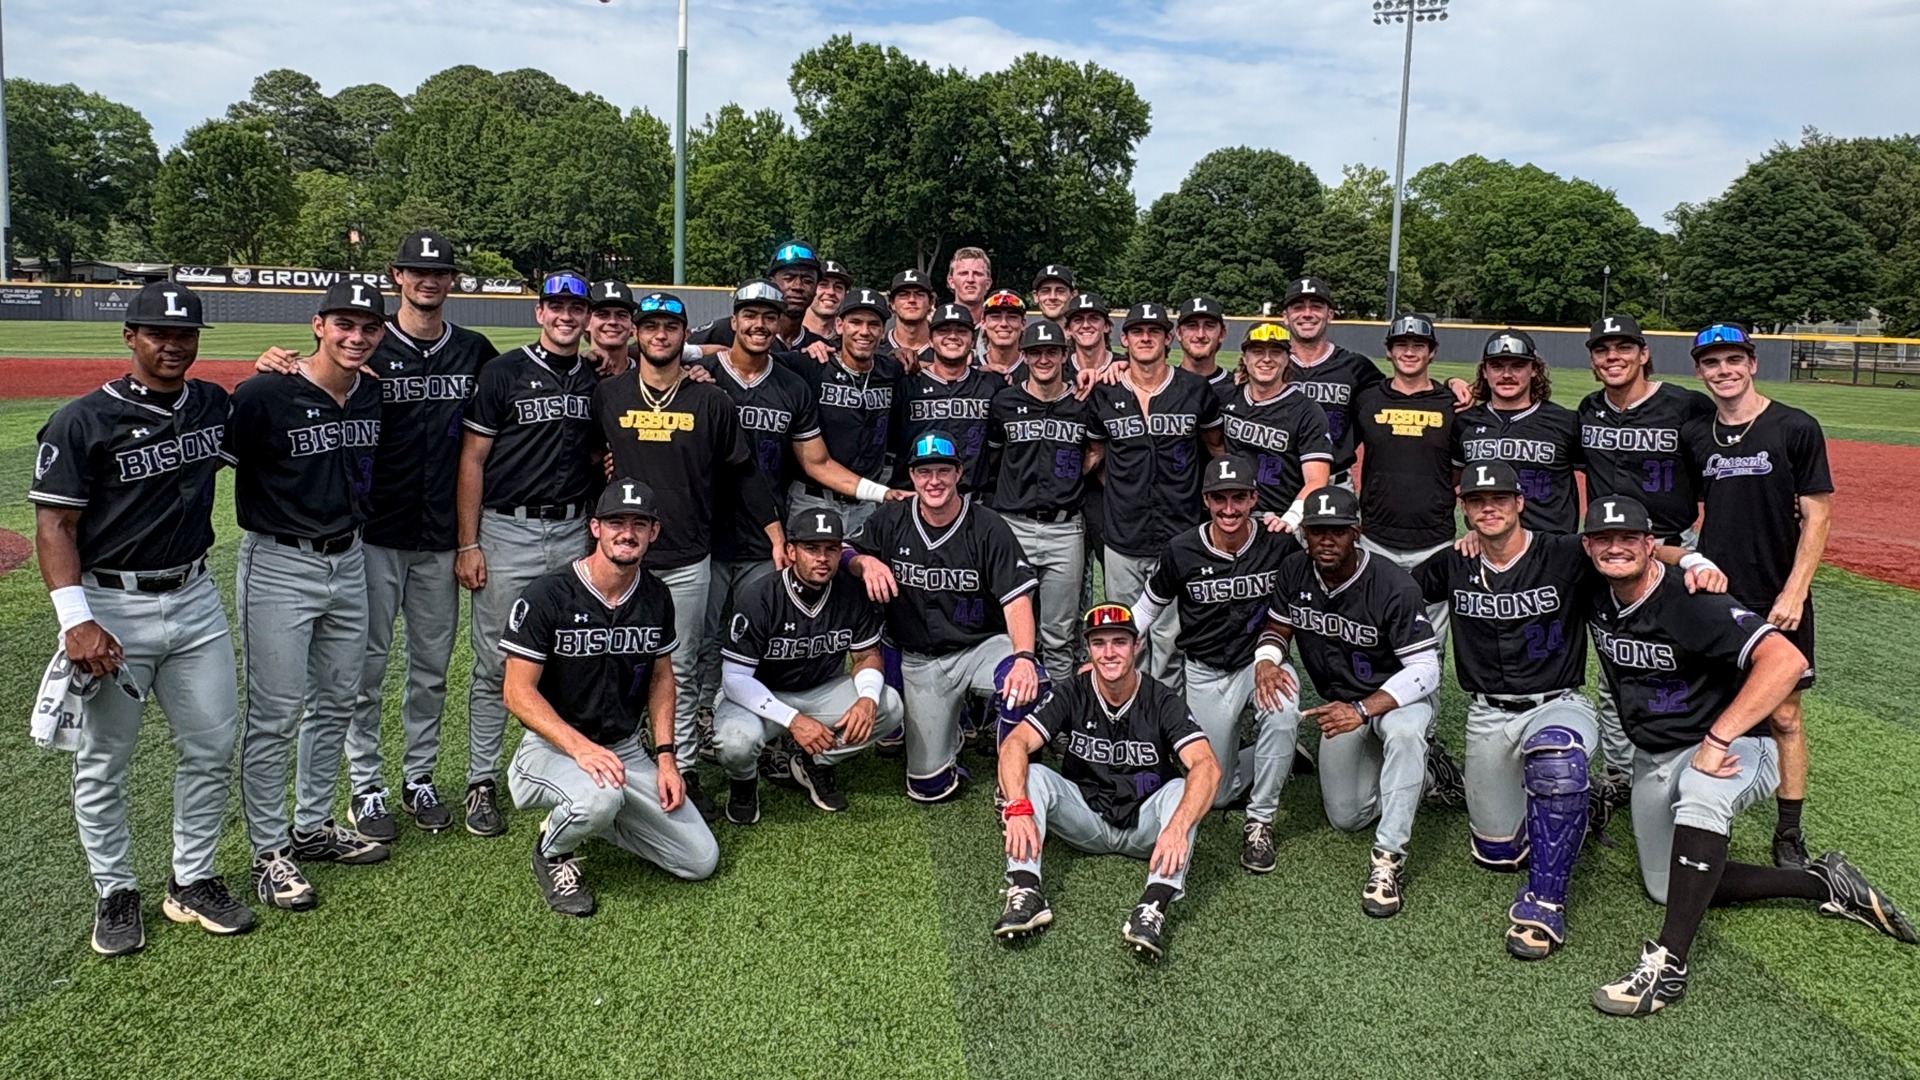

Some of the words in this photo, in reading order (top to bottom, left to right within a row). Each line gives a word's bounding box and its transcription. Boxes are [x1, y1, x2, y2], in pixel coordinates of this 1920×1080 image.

[421, 238, 438, 257] L
[827, 261, 839, 272] L
[904, 270, 917, 281] L
[1047, 265, 1058, 275] L
[54, 288, 82, 297] 370
[351, 285, 370, 307] L
[604, 282, 620, 298] L
[861, 290, 875, 304] L
[1301, 279, 1315, 293] L
[163, 292, 187, 316] L
[1080, 294, 1093, 307] L
[1142, 305, 1157, 318] L
[1193, 298, 1207, 311] L
[945, 305, 959, 319] L
[1038, 325, 1052, 340] L
[1604, 318, 1620, 333] L
[1290, 382, 1351, 405] ONS
[515, 394, 593, 424] BISON
[735, 406, 792, 433] ONS
[909, 398, 991, 421] BISONS
[1374, 409, 1443, 428] JESUS
[619, 410, 695, 431] JESUS
[1004, 419, 1087, 443] BISONS
[1104, 414, 1197, 439] BISONS
[1222, 414, 1289, 452] ISONS
[1582, 425, 1678, 452] BISONS
[1463, 439, 1556, 463] BISONS
[1219, 461, 1236, 479] L
[1257, 454, 1282, 485] 12
[1476, 466, 1495, 485] L
[1642, 460, 1674, 492] 31
[623, 485, 641, 504] L
[1318, 495, 1335, 515] L
[816, 514, 831, 533] L
[1604, 502, 1624, 523] L
[890, 559, 980, 591] BISONS
[953, 598, 984, 625] 44
[1453, 586, 1561, 619] BISONS
[1288, 603, 1378, 646] BISONS
[554, 627, 662, 656] BISONS
[764, 629, 853, 659] BISONS
[1524, 620, 1565, 659] 24
[1351, 651, 1373, 681] 6
[1648, 677, 1688, 713] 32
[1069, 730, 1160, 766] BISONS
